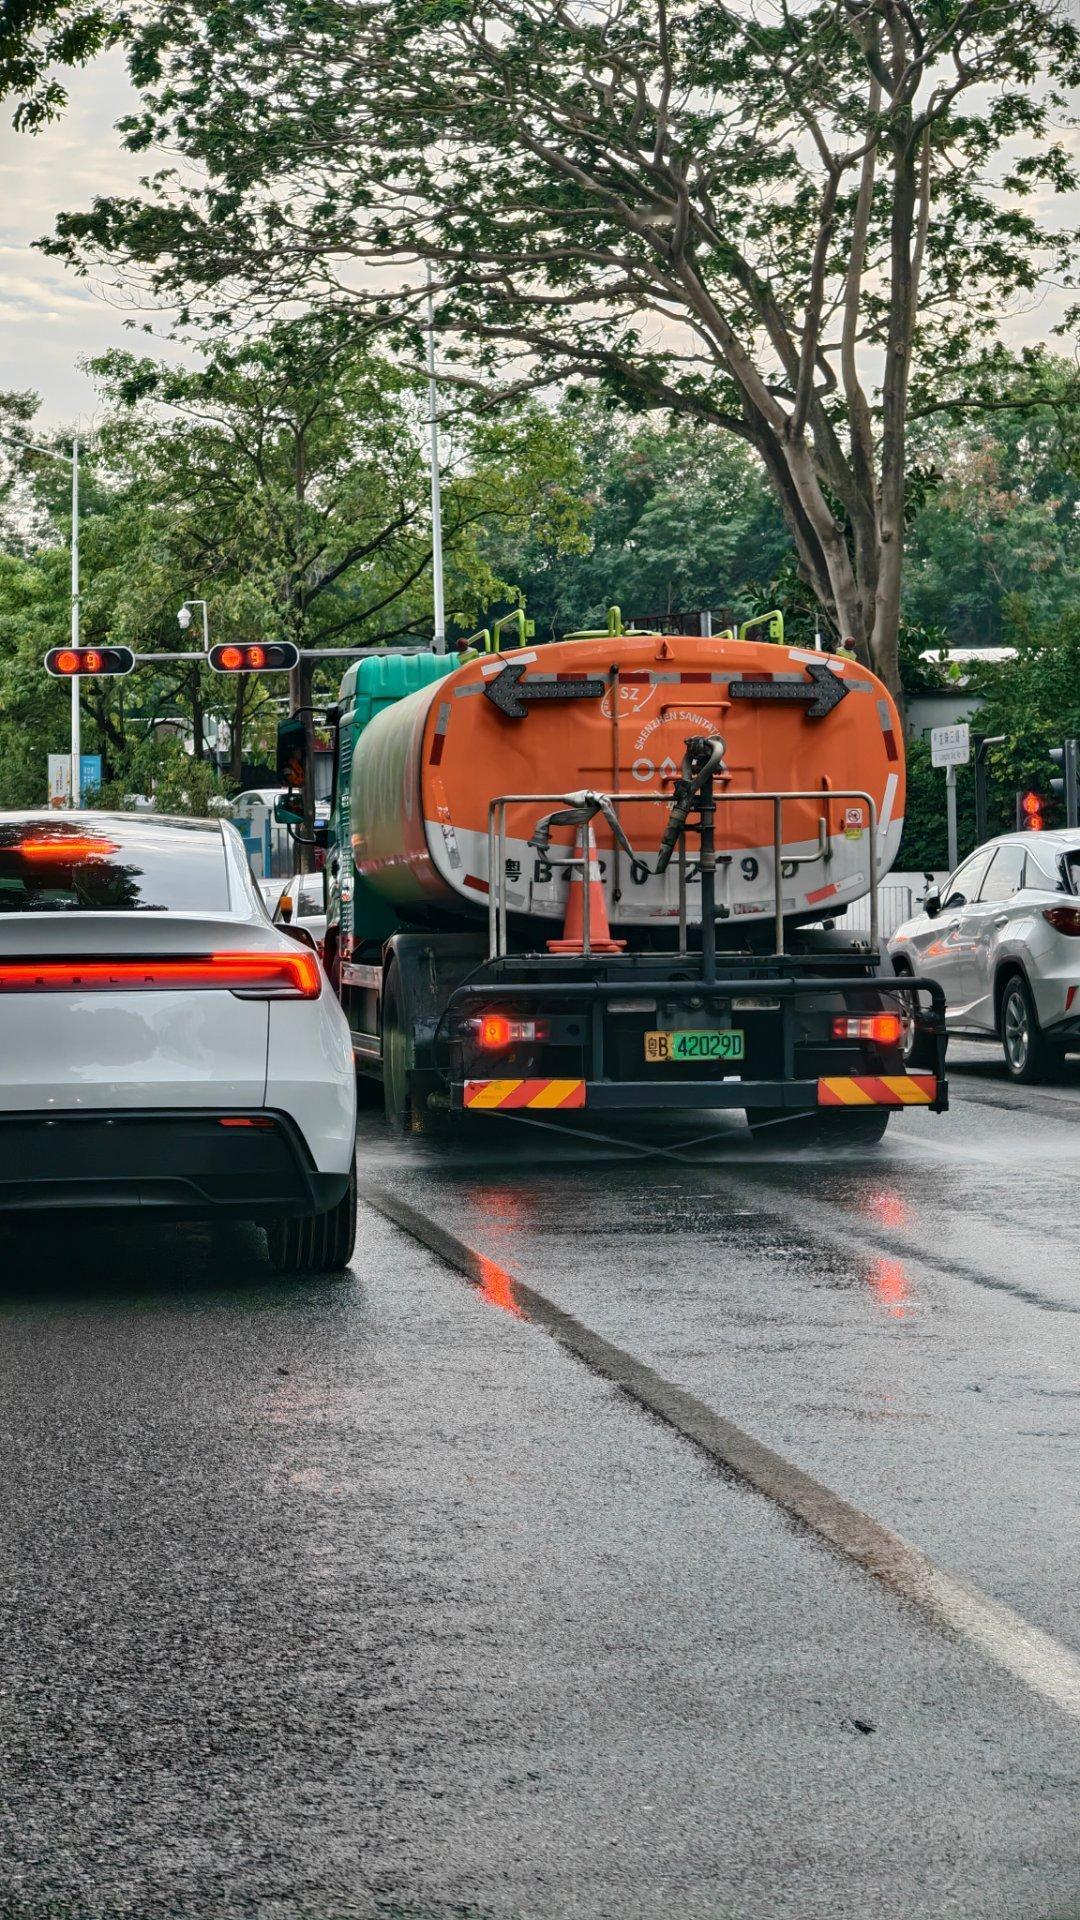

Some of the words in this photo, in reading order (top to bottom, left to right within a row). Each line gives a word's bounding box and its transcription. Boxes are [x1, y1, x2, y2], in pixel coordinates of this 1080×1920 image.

[620, 687, 639, 700] SZ
[634, 712, 677, 750] SHENZHEN
[677, 1035, 742, 1056] 42029D
